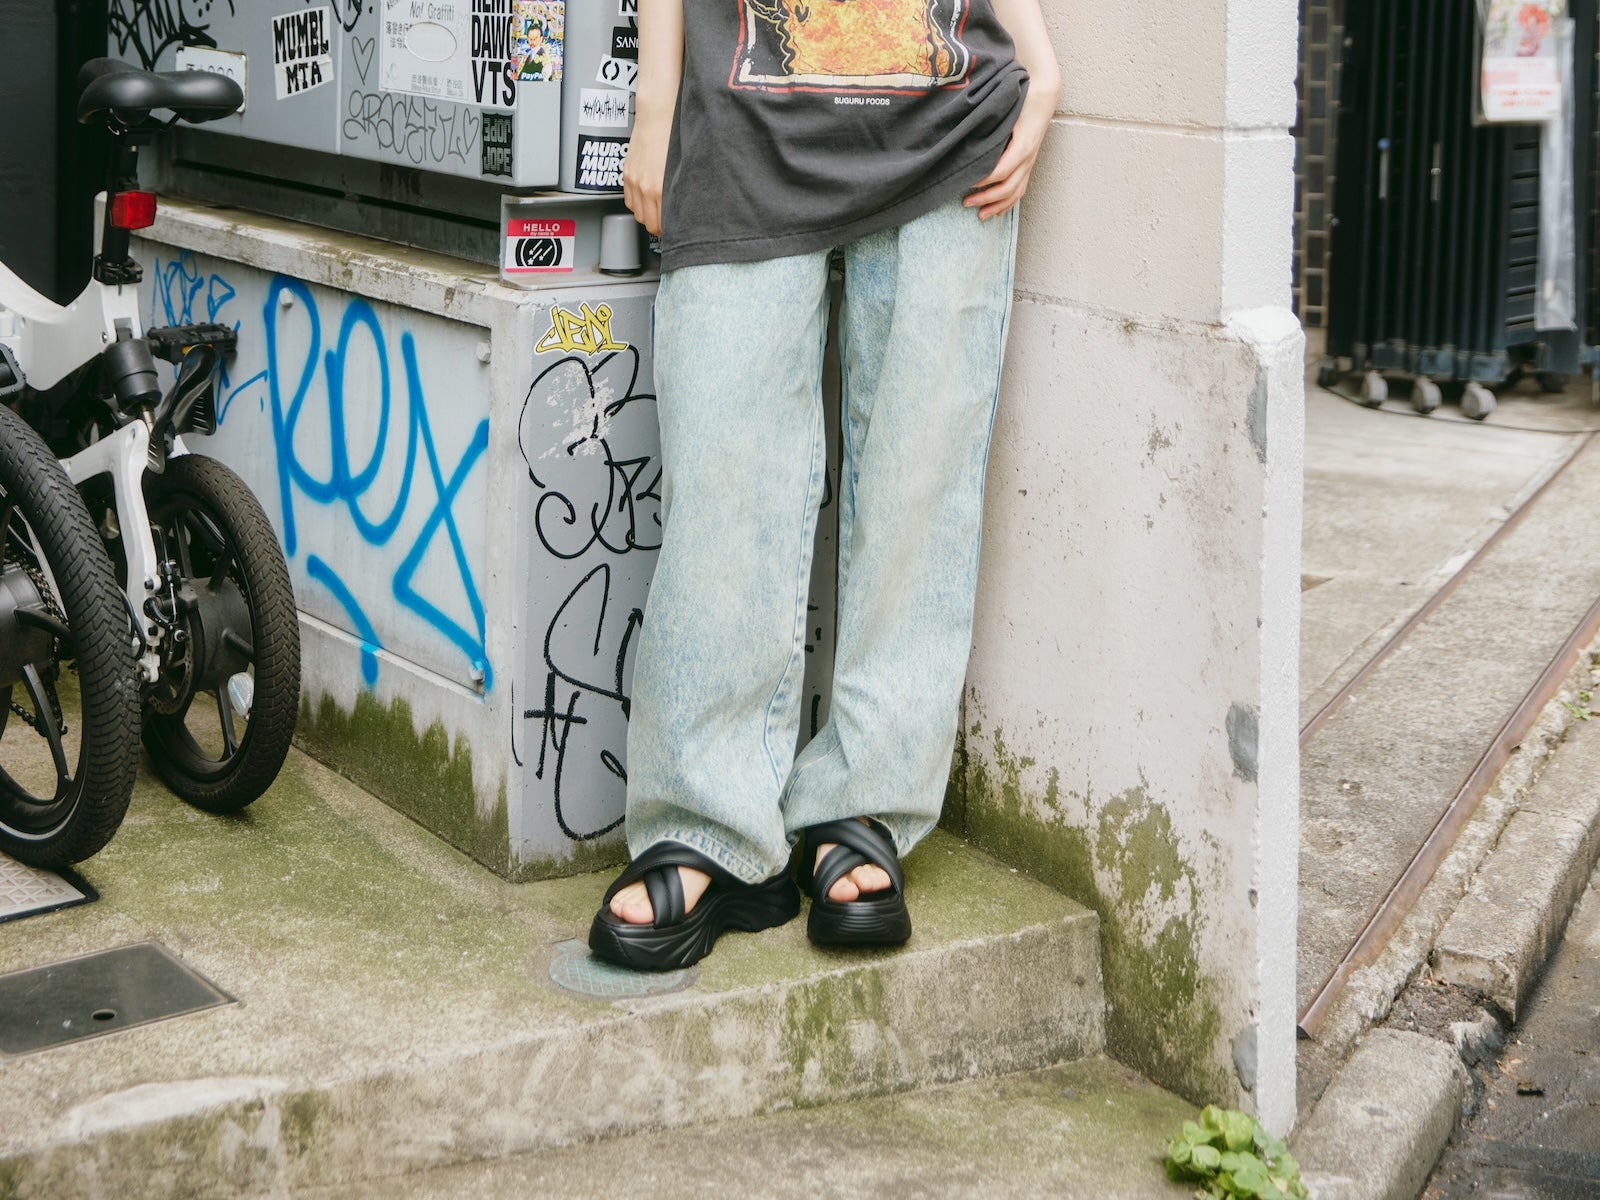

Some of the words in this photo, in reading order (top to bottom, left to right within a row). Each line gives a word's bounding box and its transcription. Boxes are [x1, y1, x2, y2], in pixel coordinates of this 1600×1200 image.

[410, 1, 424, 19] No!
[428, 3, 456, 21] Graffiti
[616, 36, 638, 48] SAN
[521, 72, 544, 80] PayPa
[472, 60, 516, 107] VTS
[834, 96, 865, 105] SUGURU
[866, 97, 891, 106] FOODS
[523, 223, 560, 232] HELLO
